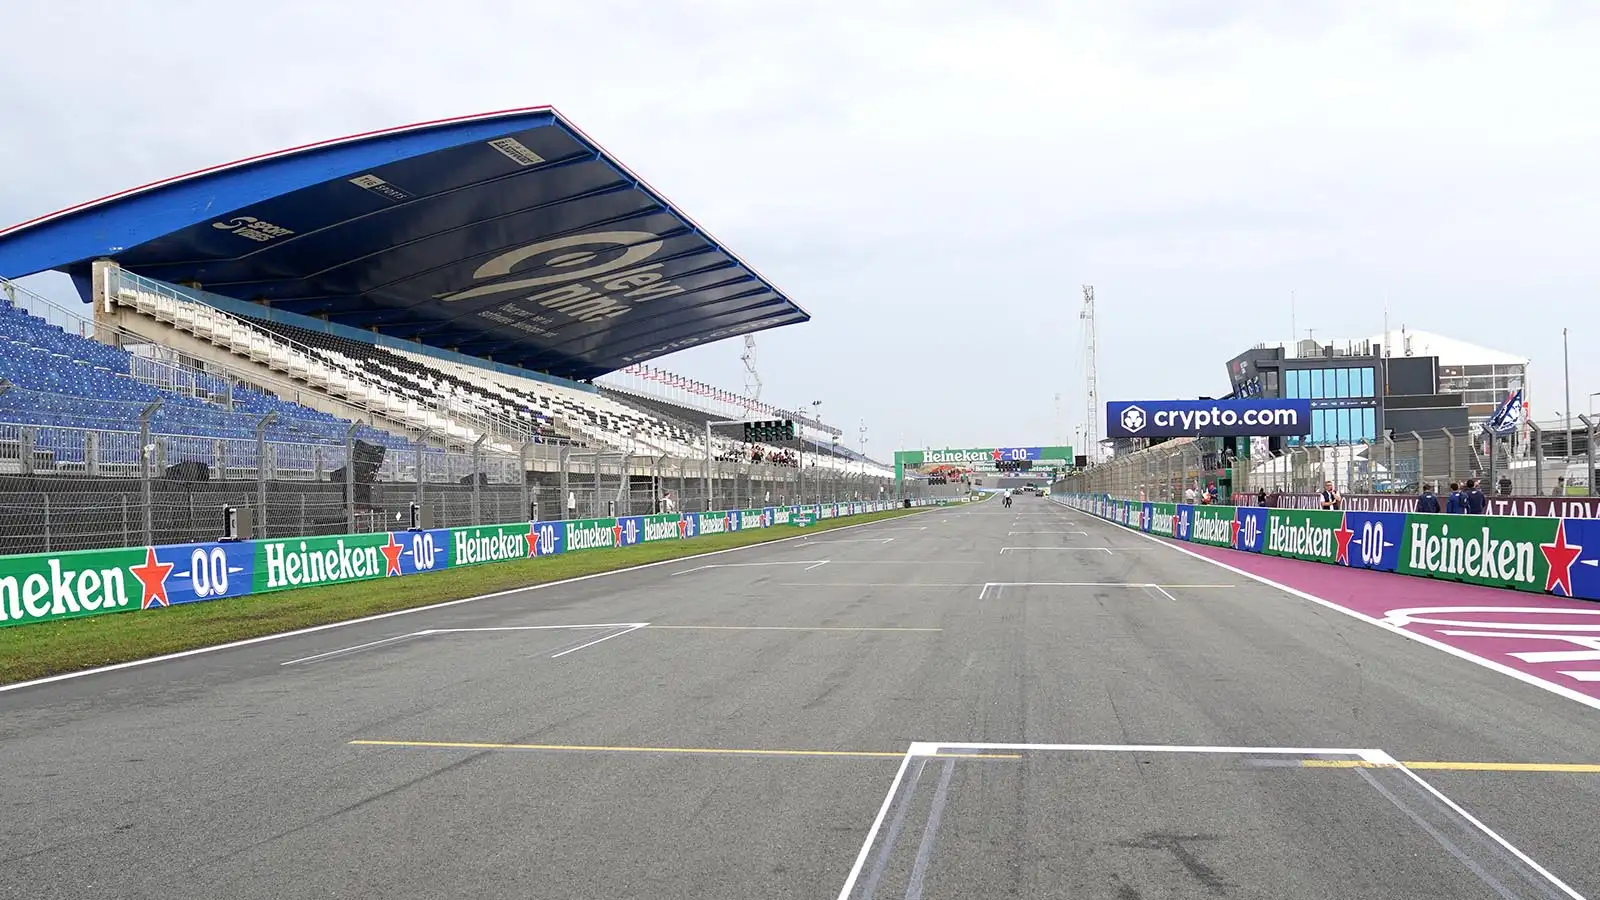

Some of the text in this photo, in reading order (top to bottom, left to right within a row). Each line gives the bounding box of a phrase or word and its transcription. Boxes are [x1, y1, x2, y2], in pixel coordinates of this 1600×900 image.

[248, 221, 295, 237] SPORT
[1153, 406, 1297, 430] crypto.com
[922, 450, 988, 463] Heineken
[1340, 497, 1419, 513] QATAR AIRWAY
[1485, 500, 1537, 517] ATAR
[566, 521, 613, 551] Heineken
[643, 516, 678, 542] Heineken
[699, 514, 724, 535] Heineken
[1192, 510, 1229, 543] Heineken
[455, 528, 524, 565] Heineken
[1268, 515, 1384, 565] Heineken 0.0
[1409, 523, 1535, 583] Heineken
[191, 547, 229, 598] 0.0
[264, 533, 435, 587] Heineken 0.0
